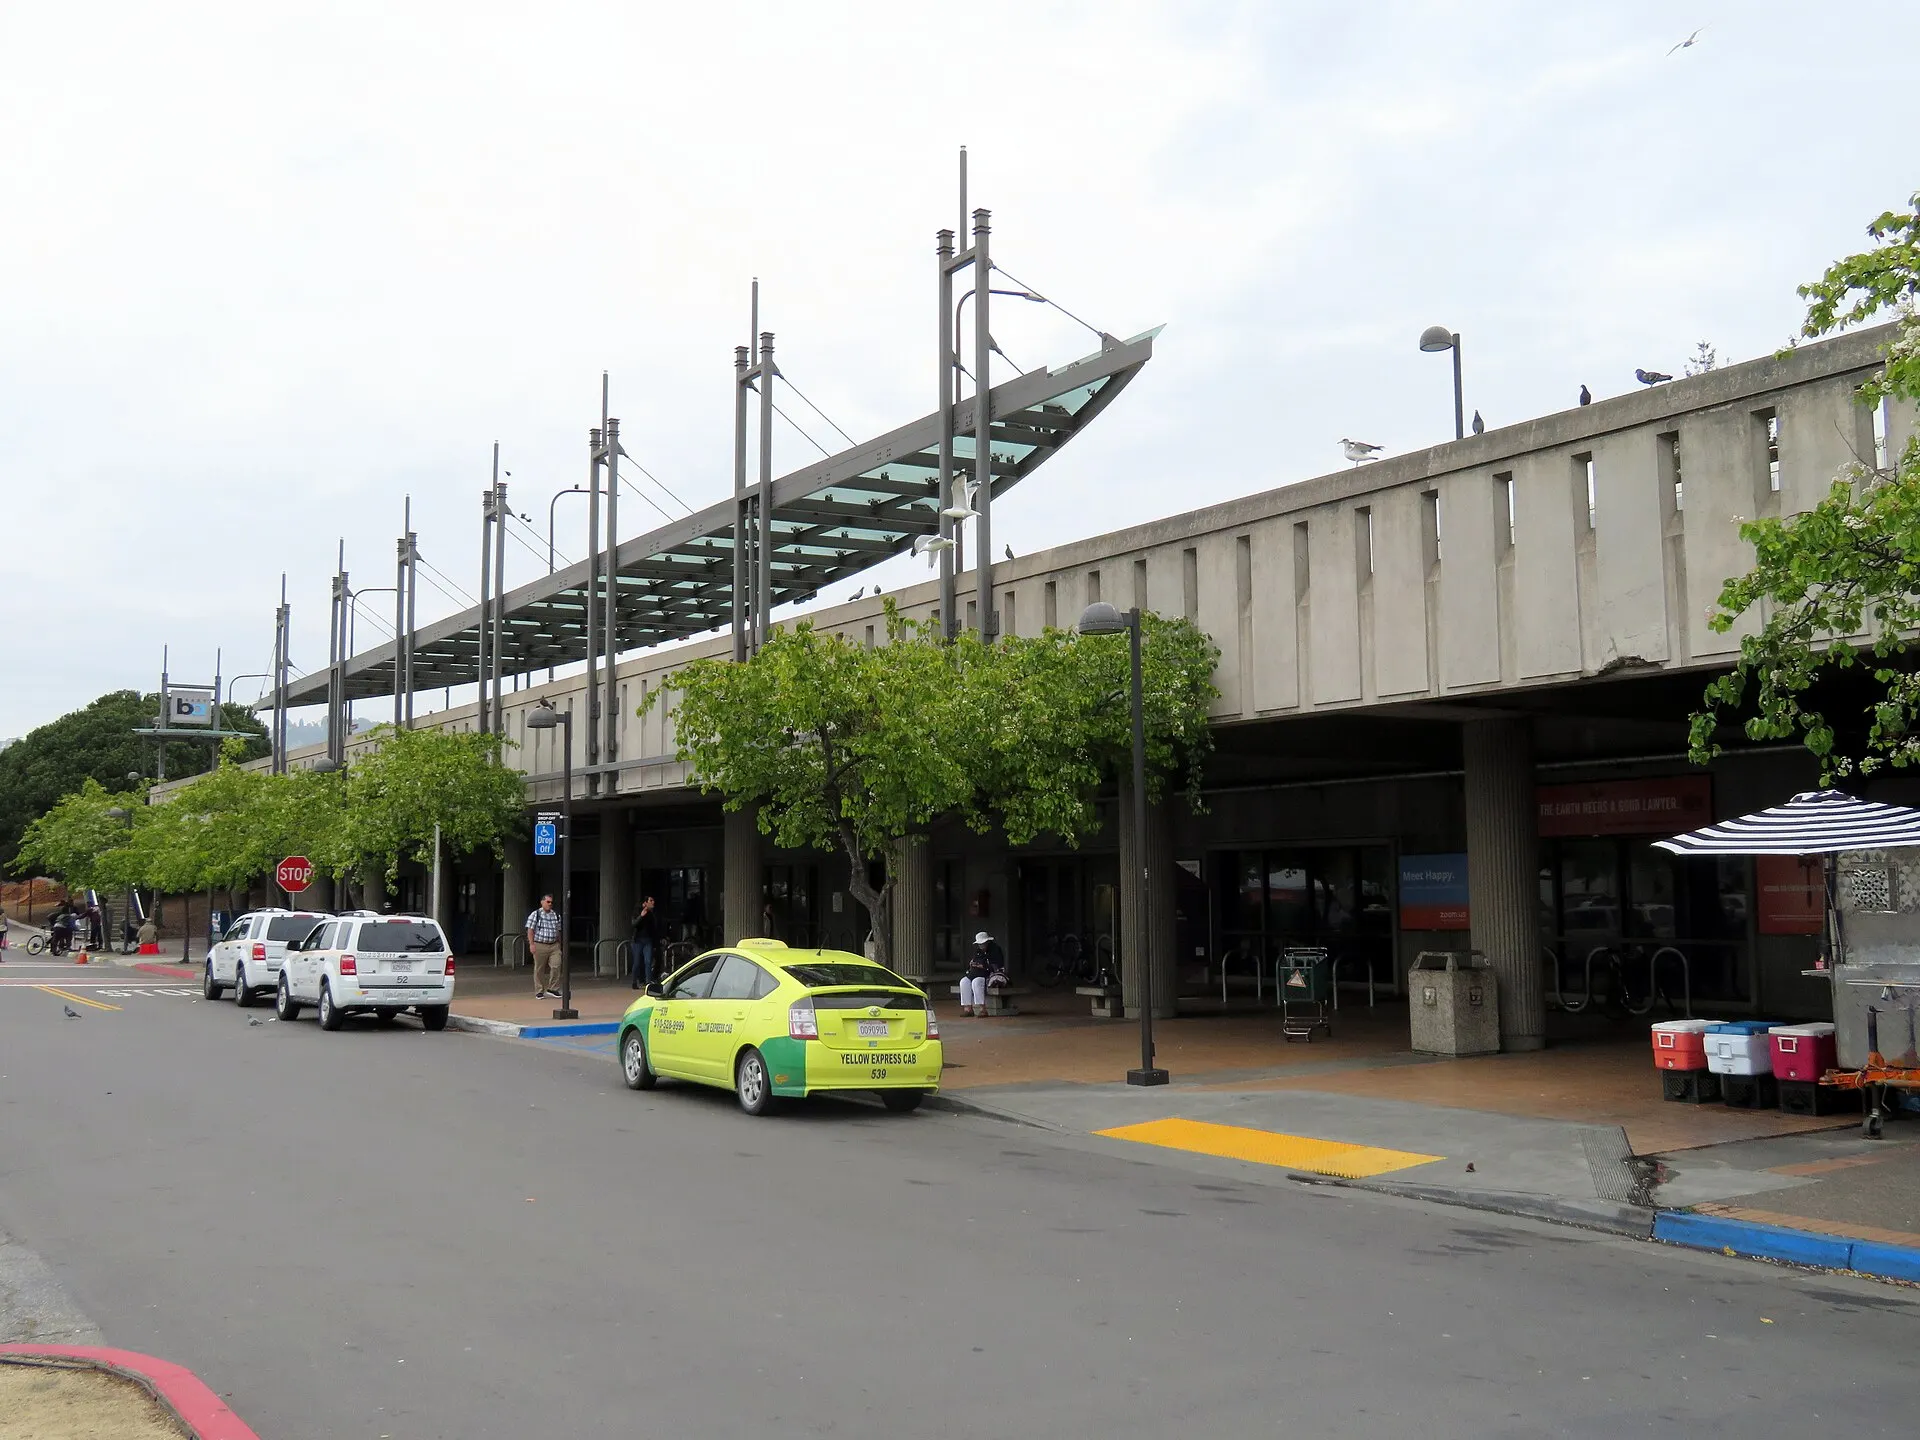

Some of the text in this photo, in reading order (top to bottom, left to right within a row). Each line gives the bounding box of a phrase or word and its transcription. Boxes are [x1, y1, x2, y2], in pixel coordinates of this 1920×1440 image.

[1540, 803, 1554, 816] THE
[1556, 801, 1580, 816] EARTH
[537, 836, 553, 845] Drop
[540, 845, 550, 853] Off
[279, 867, 312, 881] STOP
[1402, 871, 1424, 881] Meet
[396, 975, 408, 984] 52
[841, 1054, 917, 1065] YELLOW EXPRESS CAB
[871, 1069, 887, 1079] 539
